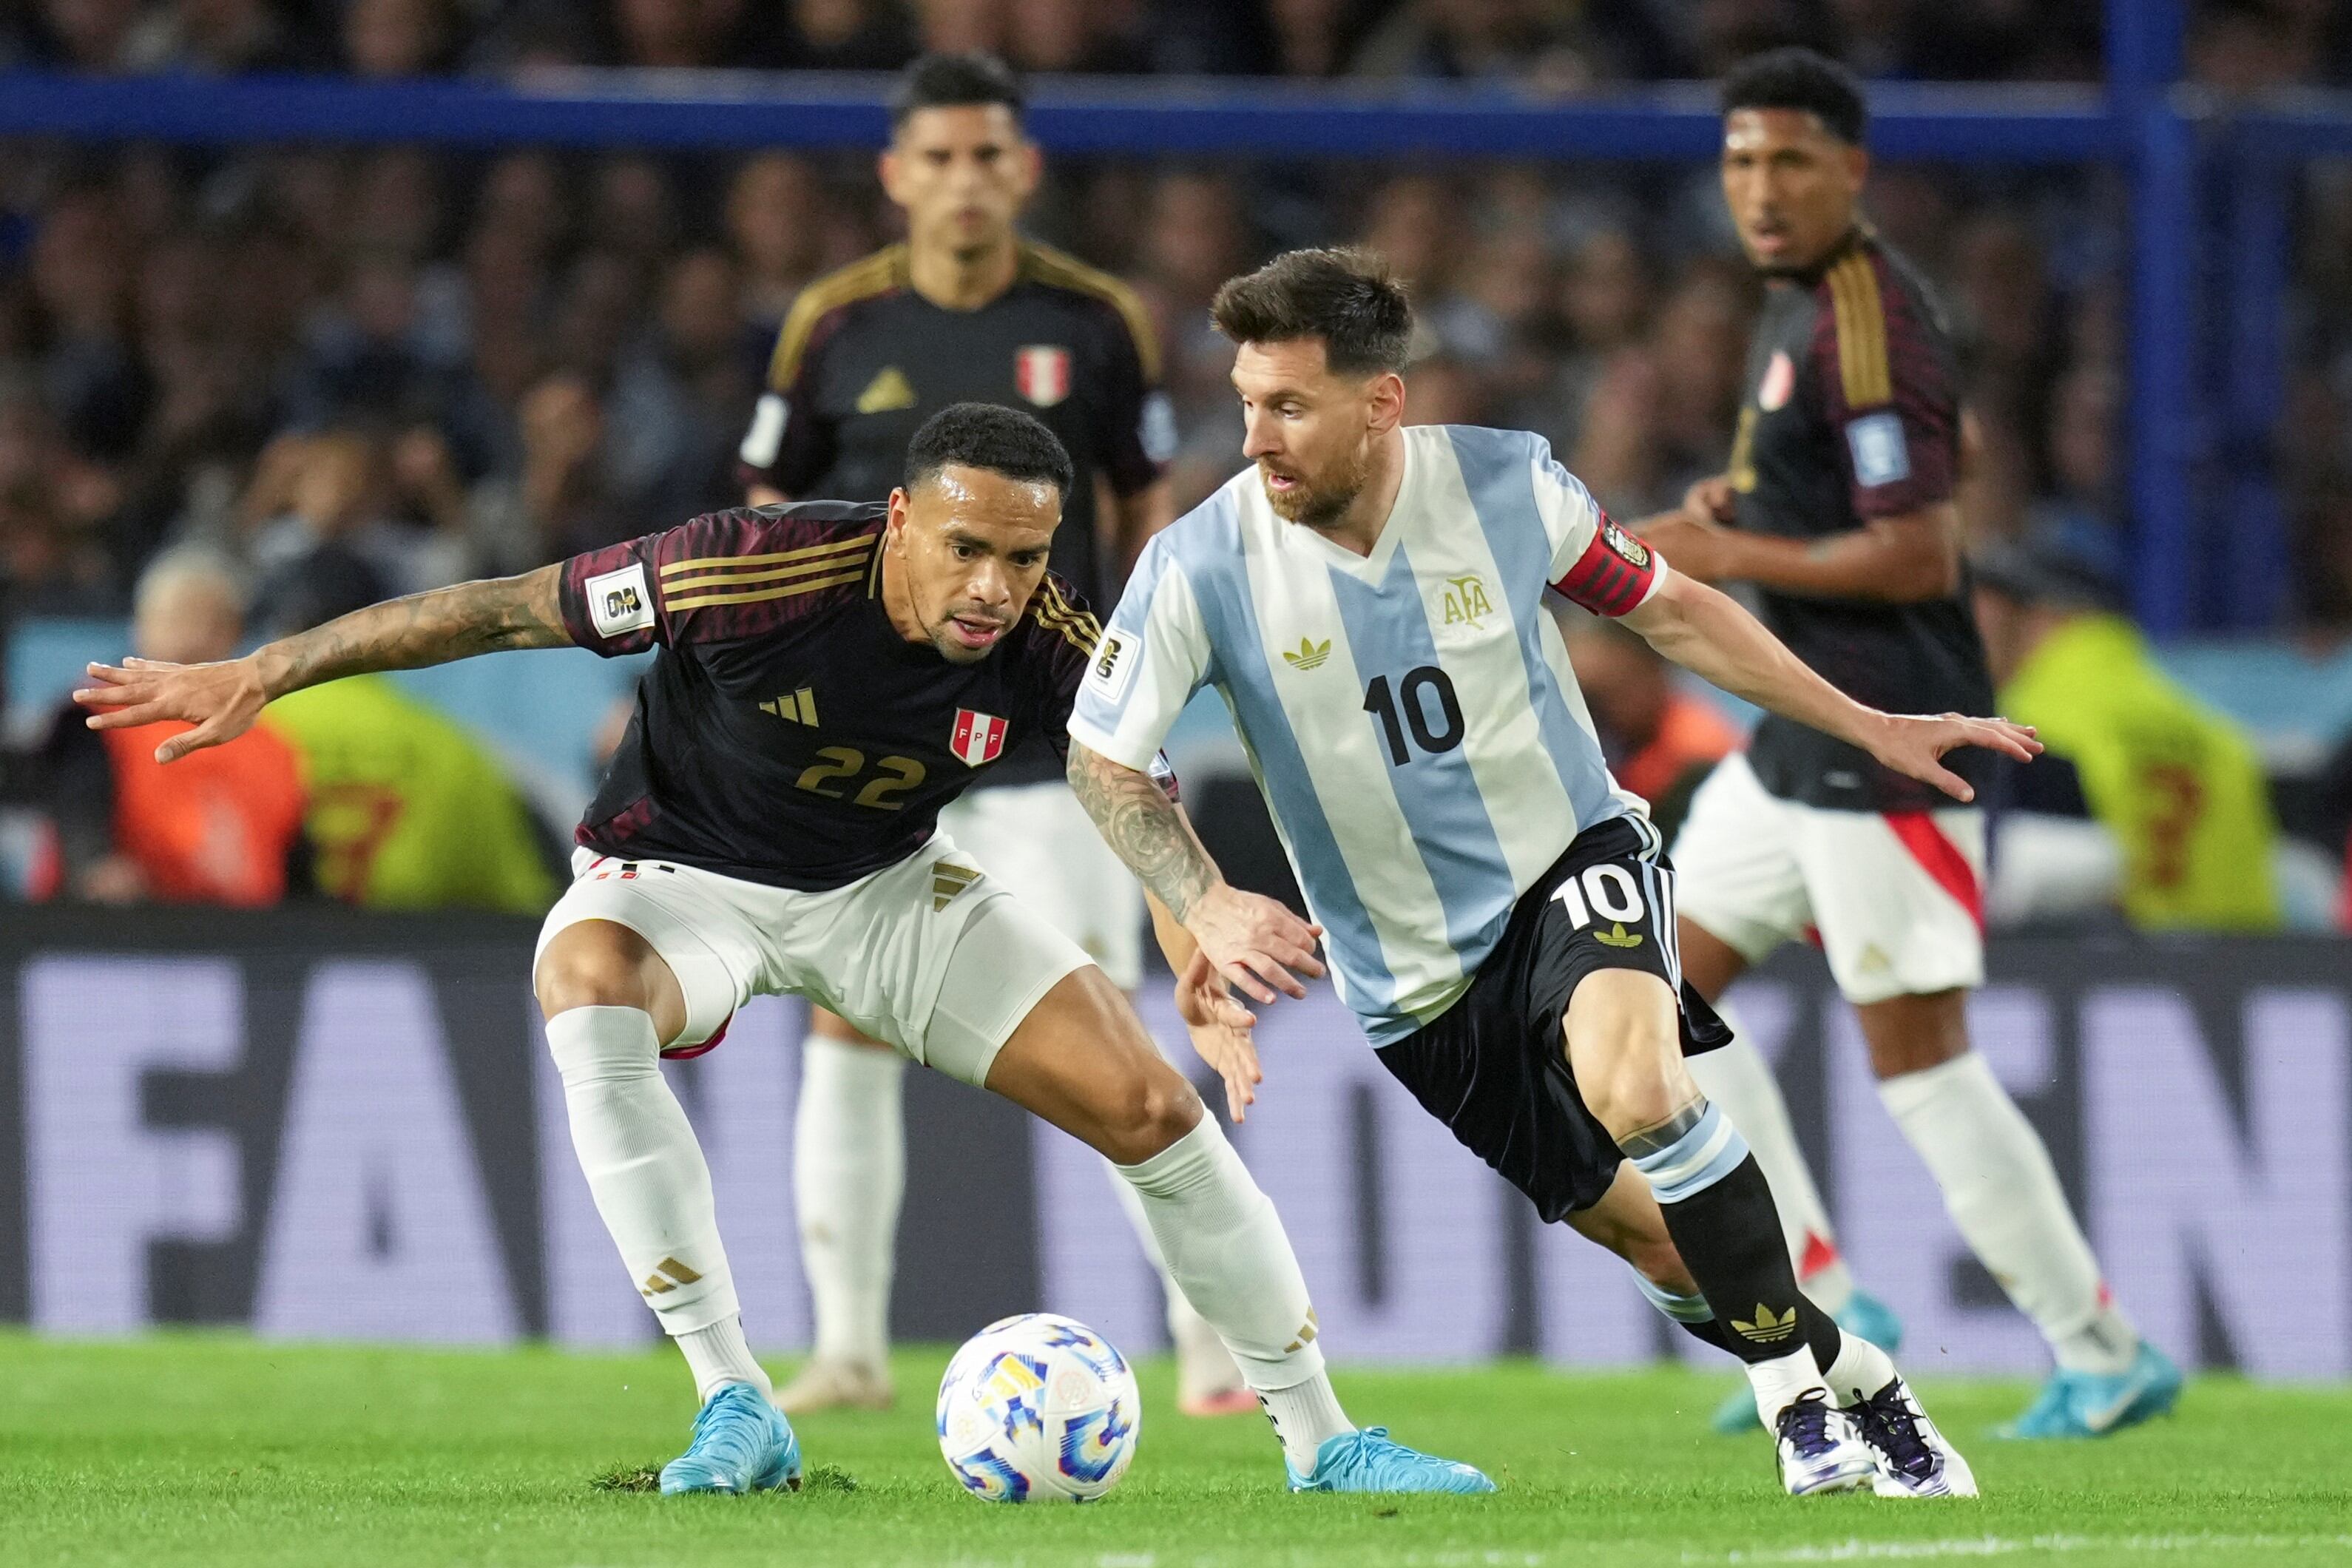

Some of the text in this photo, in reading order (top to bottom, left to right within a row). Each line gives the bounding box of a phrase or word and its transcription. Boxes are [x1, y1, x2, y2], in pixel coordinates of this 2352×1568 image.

[1444, 574, 1493, 630] AFA
[1363, 665, 1465, 767] 10
[795, 746, 927, 811] 22
[1550, 863, 1645, 930] 10
[1032, 969, 2349, 1382] OEN
